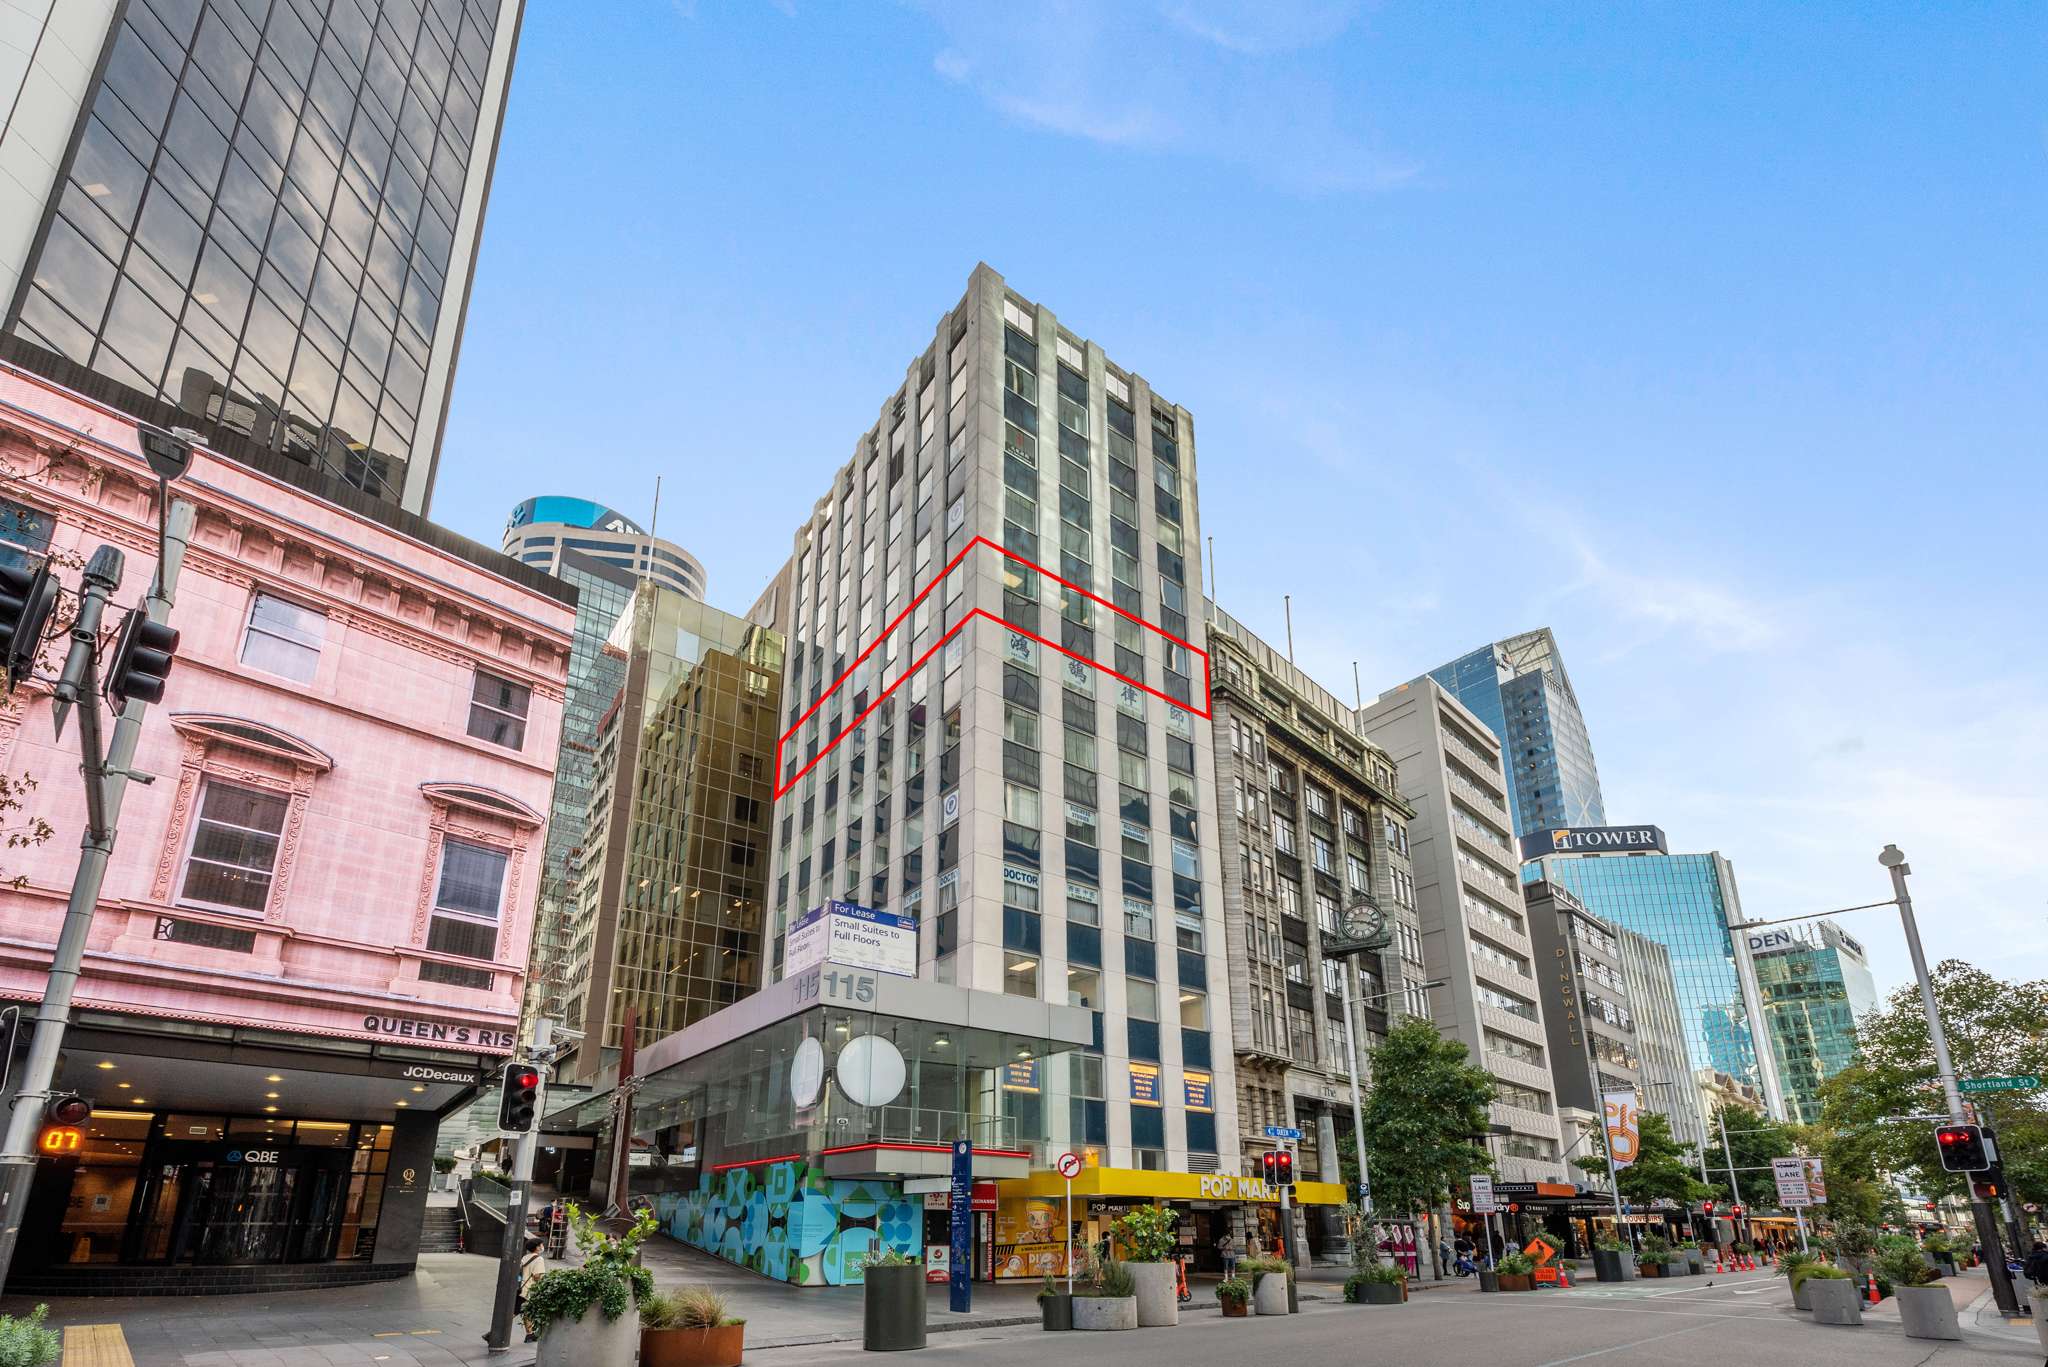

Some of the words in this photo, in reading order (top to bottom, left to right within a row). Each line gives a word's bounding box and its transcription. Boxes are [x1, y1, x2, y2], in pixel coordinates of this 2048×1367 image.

[1571, 830, 1655, 846] TOWER
[1003, 867, 1039, 885] DOCTOR
[834, 903, 848, 913] For
[851, 908, 875, 920] Lease
[834, 918, 859, 931] Small
[862, 924, 888, 937] Suites
[891, 930, 899, 939] to
[834, 930, 850, 940] Full
[853, 934, 880, 947] Floors
[824, 971, 874, 1003] 115
[1555, 948, 1581, 1046] DINGWALL
[363, 1015, 471, 1042] QUEEN'S
[403, 1066, 475, 1083] JCDecaux
[1322, 1087, 1336, 1097] The
[1964, 1080, 2013, 1090] Shortland
[2018, 1078, 2030, 1087] St
[46, 1131, 78, 1148] 07
[245, 1150, 279, 1163] QBE
[1200, 1175, 1233, 1198] POP
[1092, 1204, 1106, 1212] POP
